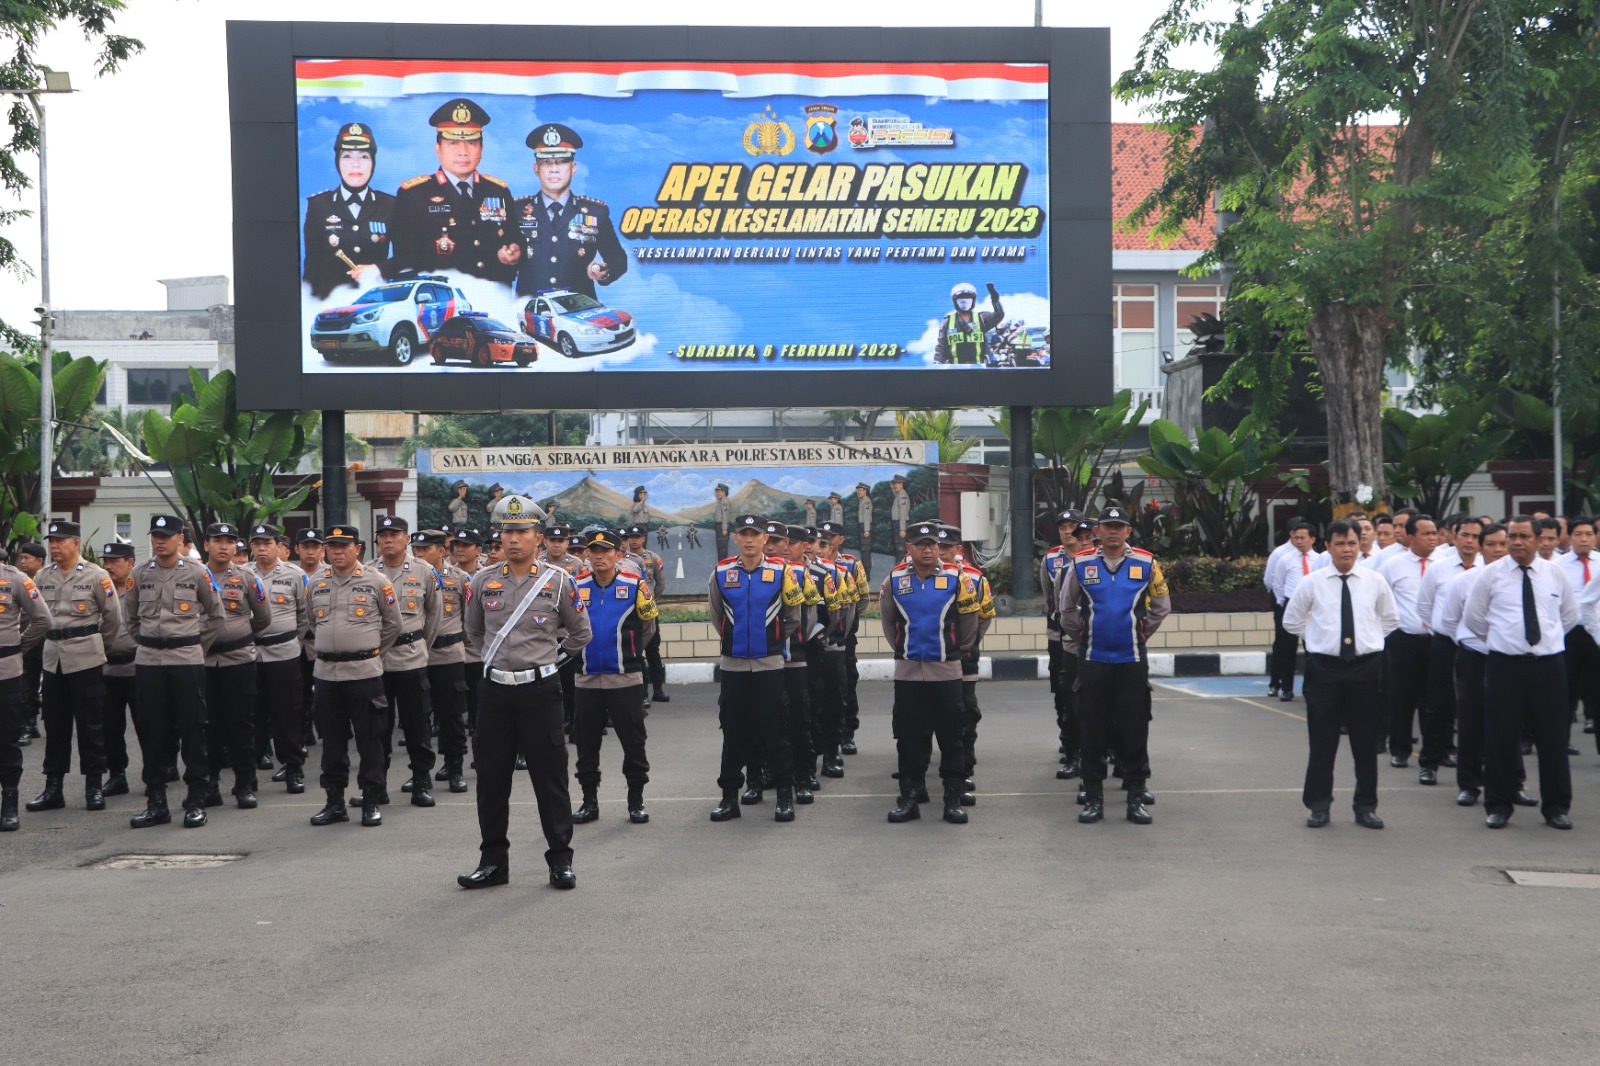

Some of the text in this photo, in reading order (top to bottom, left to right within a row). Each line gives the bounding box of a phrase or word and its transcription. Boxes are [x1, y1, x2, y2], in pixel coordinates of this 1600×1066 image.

[873, 129, 953, 141] PRESISI
[657, 163, 1022, 201] APEL GELAR PASUKAN
[620, 207, 1039, 233] OPERASI KESELAMATAN SEMERU 2023
[733, 247, 790, 258] BERLALU
[795, 247, 842, 258] LINTAS
[848, 246, 881, 258] YANG
[885, 246, 946, 258] PERTAMA
[951, 246, 977, 257] DAN
[676, 344, 756, 358] SURABAYA,
[762, 344, 773, 357] 6
[780, 344, 854, 357] FEBRUARI
[858, 343, 898, 357] 2023
[443, 446, 913, 468] SAYA BANGGA SEBAGAI BHAYANGKARA POLRESTABES SURABAYA
[175, 582, 196, 590] POLRI
[272, 579, 292, 587] POLRI
[352, 586, 372, 594] POLRI
